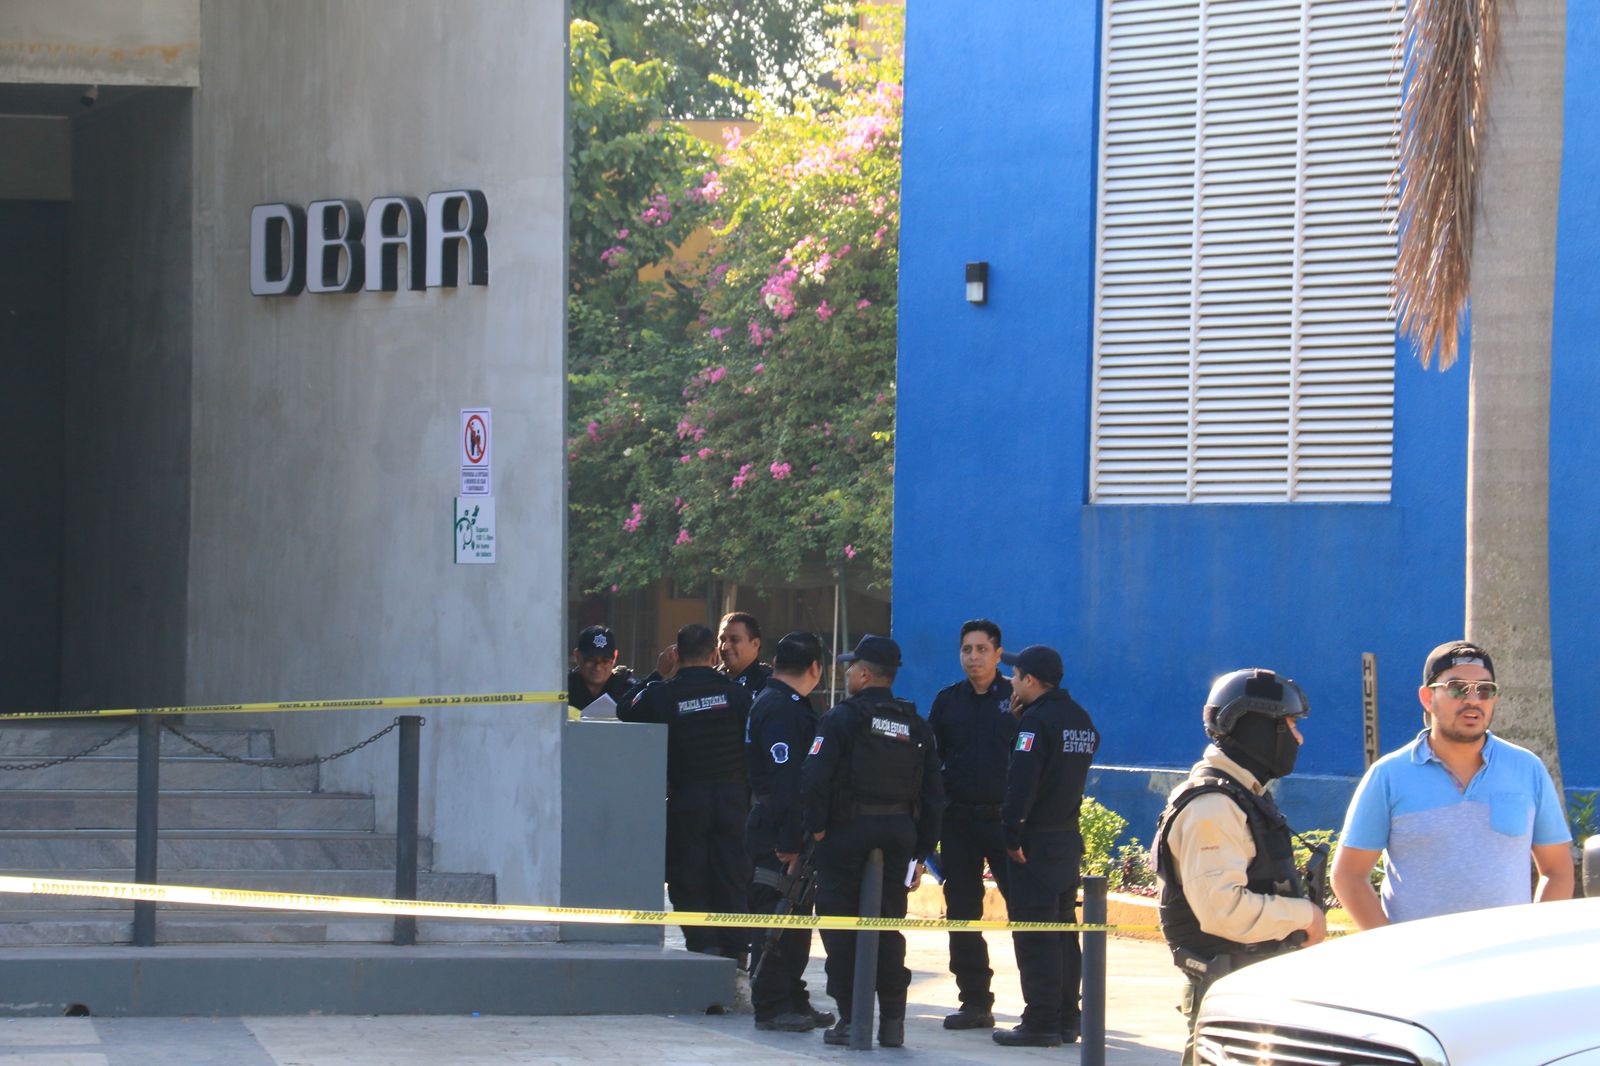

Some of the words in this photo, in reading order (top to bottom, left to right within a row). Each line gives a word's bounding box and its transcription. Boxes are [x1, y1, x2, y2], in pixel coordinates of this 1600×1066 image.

[250, 190, 488, 297] DBAR
[700, 694, 727, 708] ESTATAL
[890, 721, 910, 736] ESTATAL
[1063, 729, 1096, 742] POLICÍA
[1063, 740, 1095, 754] ESTATAL
